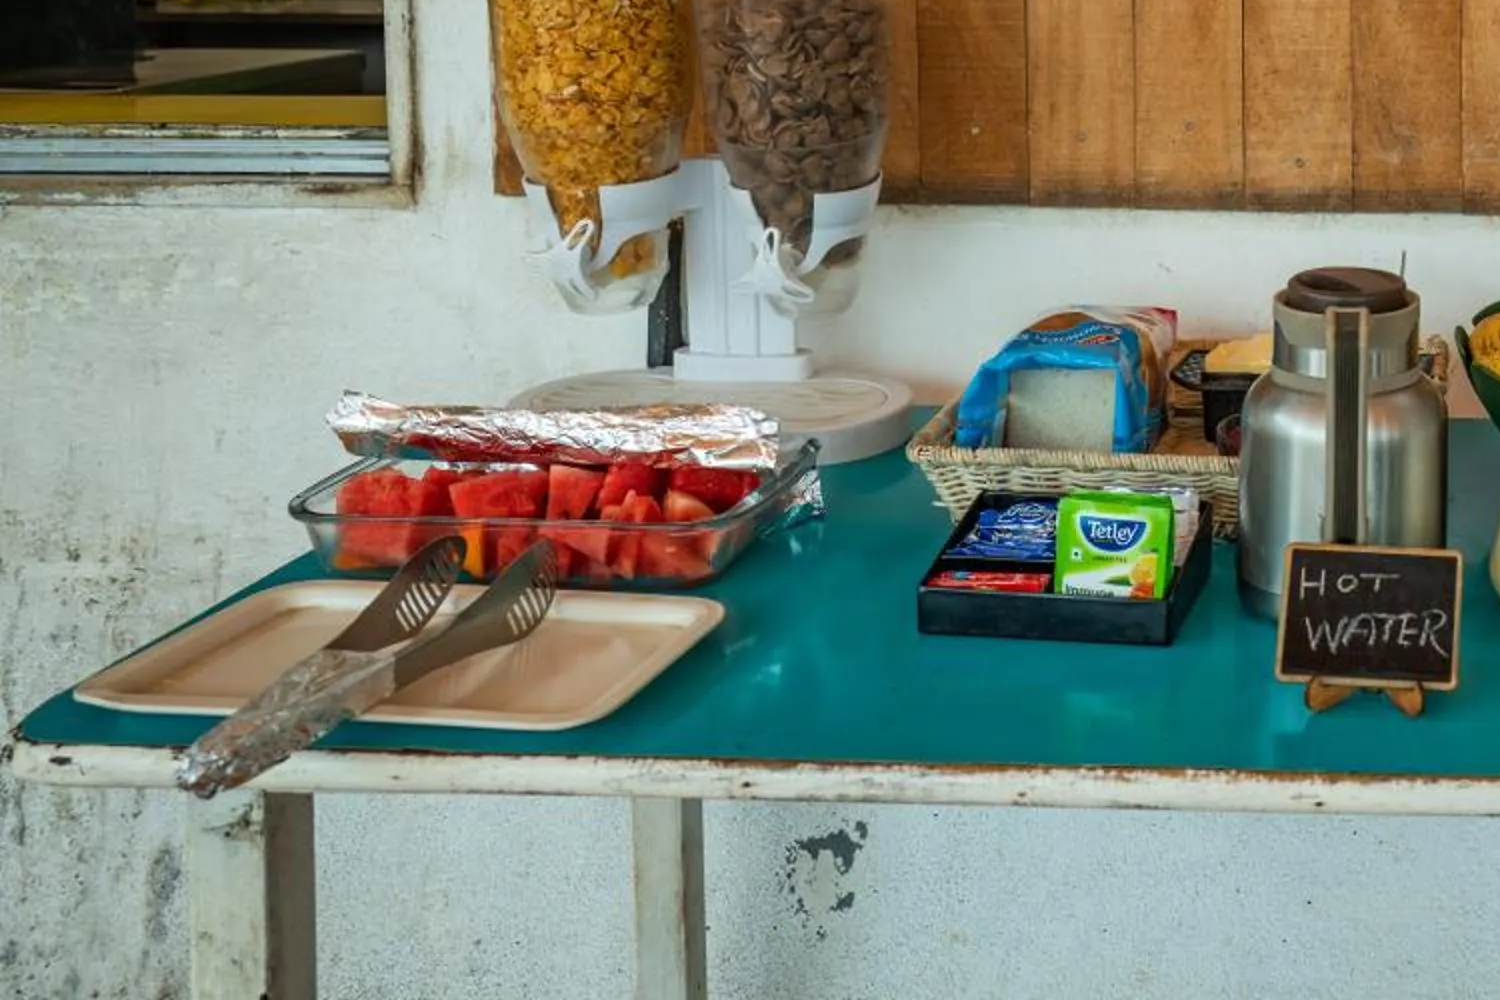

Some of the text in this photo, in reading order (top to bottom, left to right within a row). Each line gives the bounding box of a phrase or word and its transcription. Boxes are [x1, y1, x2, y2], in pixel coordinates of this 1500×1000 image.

[1087, 519, 1139, 546] Tetley
[1300, 565, 1400, 600] HOT
[1304, 609, 1449, 658] WATER
